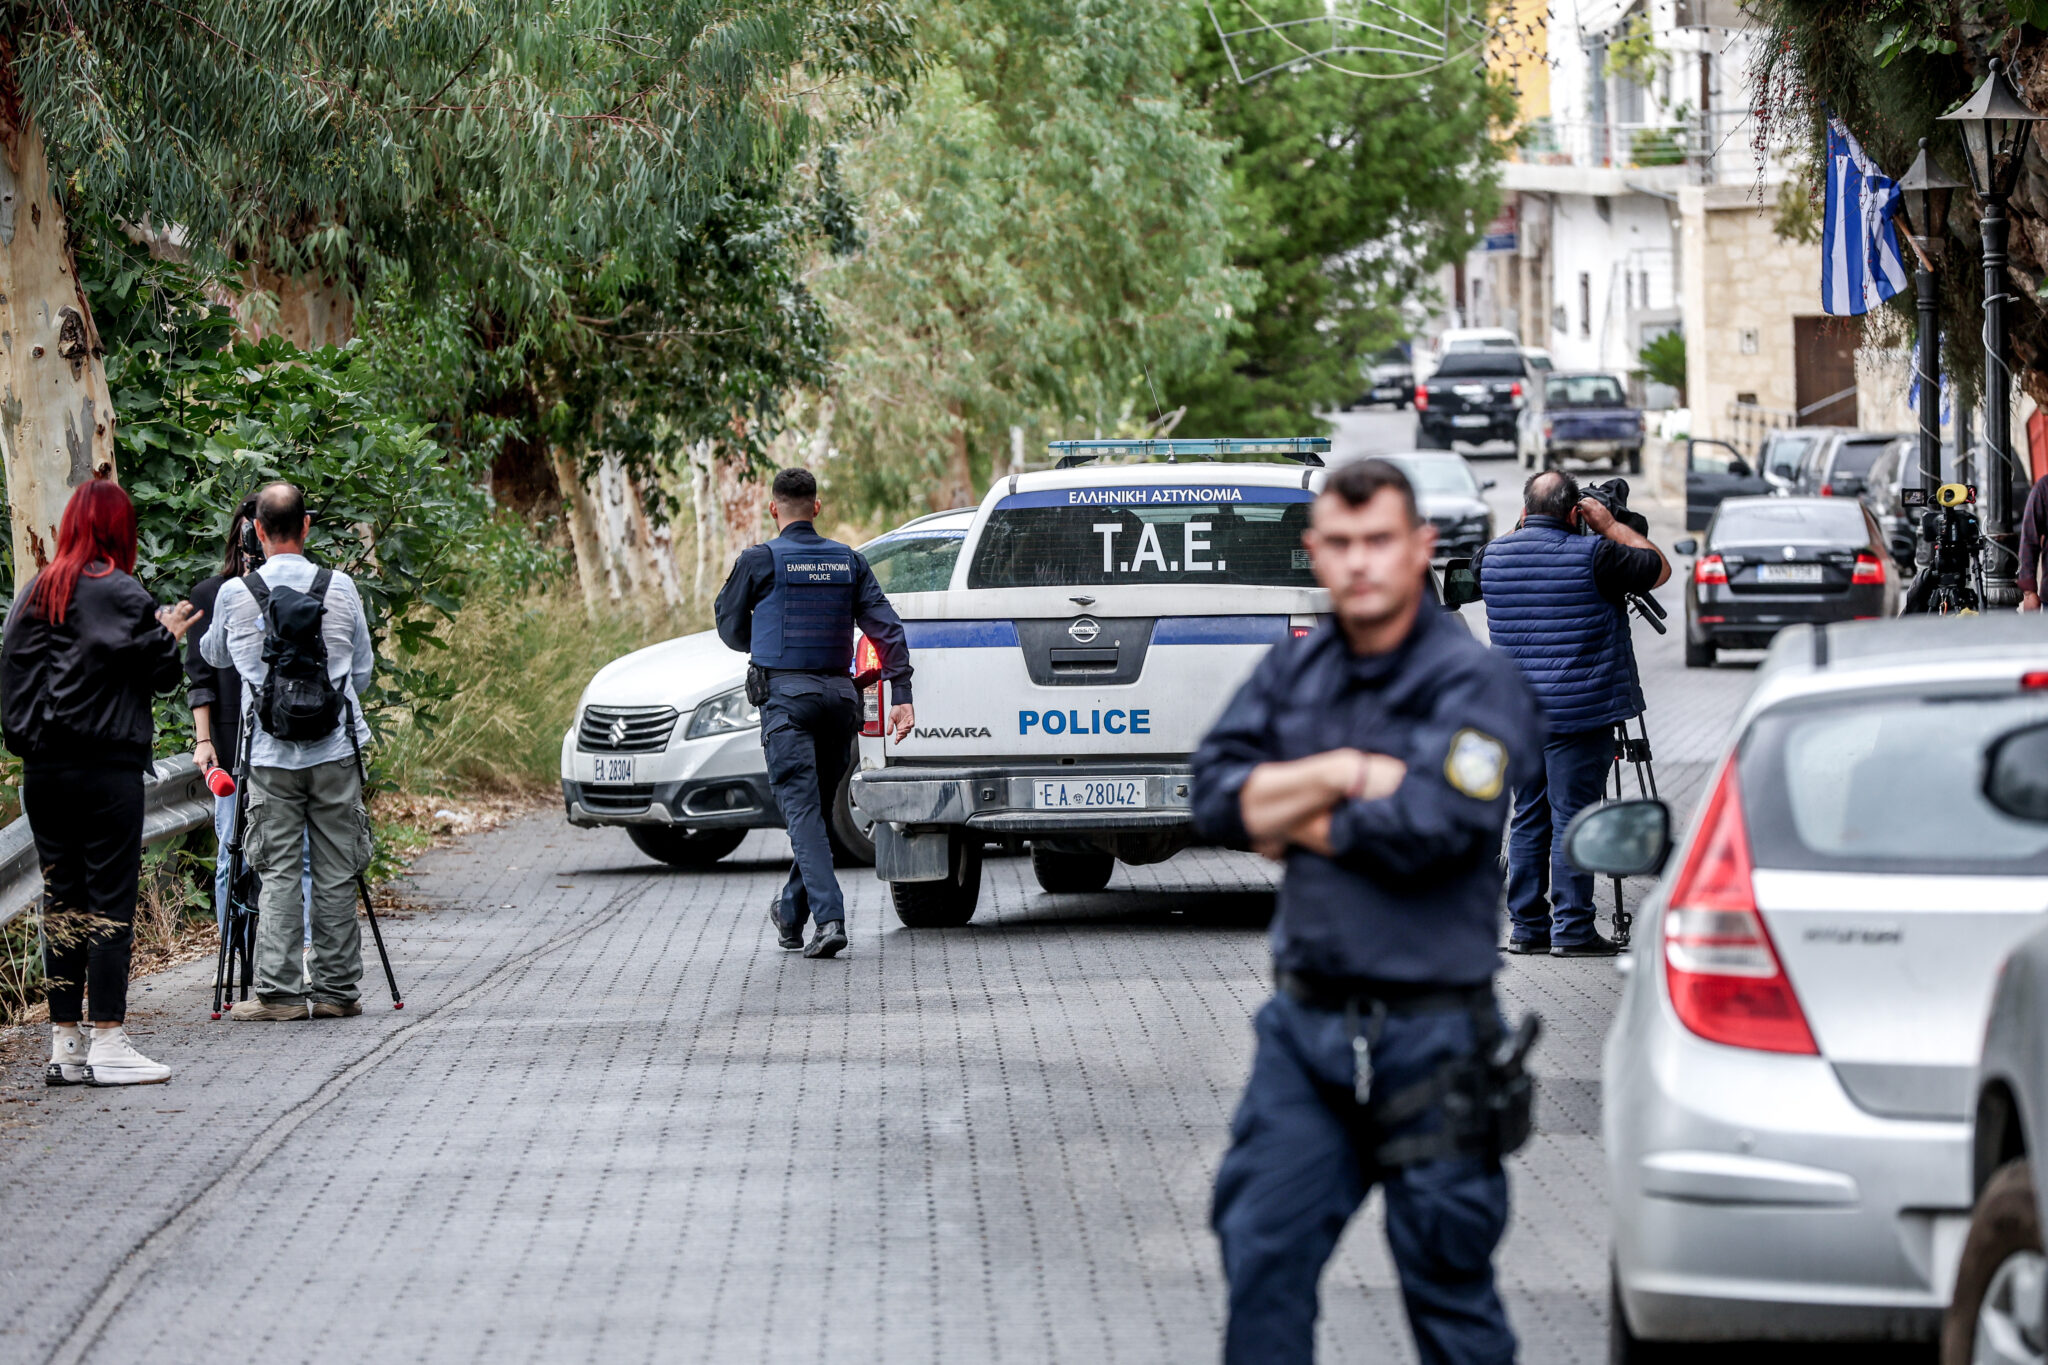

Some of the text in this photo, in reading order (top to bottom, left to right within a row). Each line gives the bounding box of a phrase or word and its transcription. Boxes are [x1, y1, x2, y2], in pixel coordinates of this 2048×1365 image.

[1068, 488, 1243, 504] ΕΛΛΗΝΙΚΗ ΑΣΤΥΝΟΜΙΑ
[786, 563, 850, 572] ΕΛΛΗΝΙΚΗ ΑΣΤΥΝΟΜΙΑ
[808, 573, 832, 581] POLICE
[1018, 709, 1151, 735] POLICE
[914, 726, 992, 739] NAVARA
[608, 759, 632, 781] 28304
[1084, 782, 1136, 806] 28042
